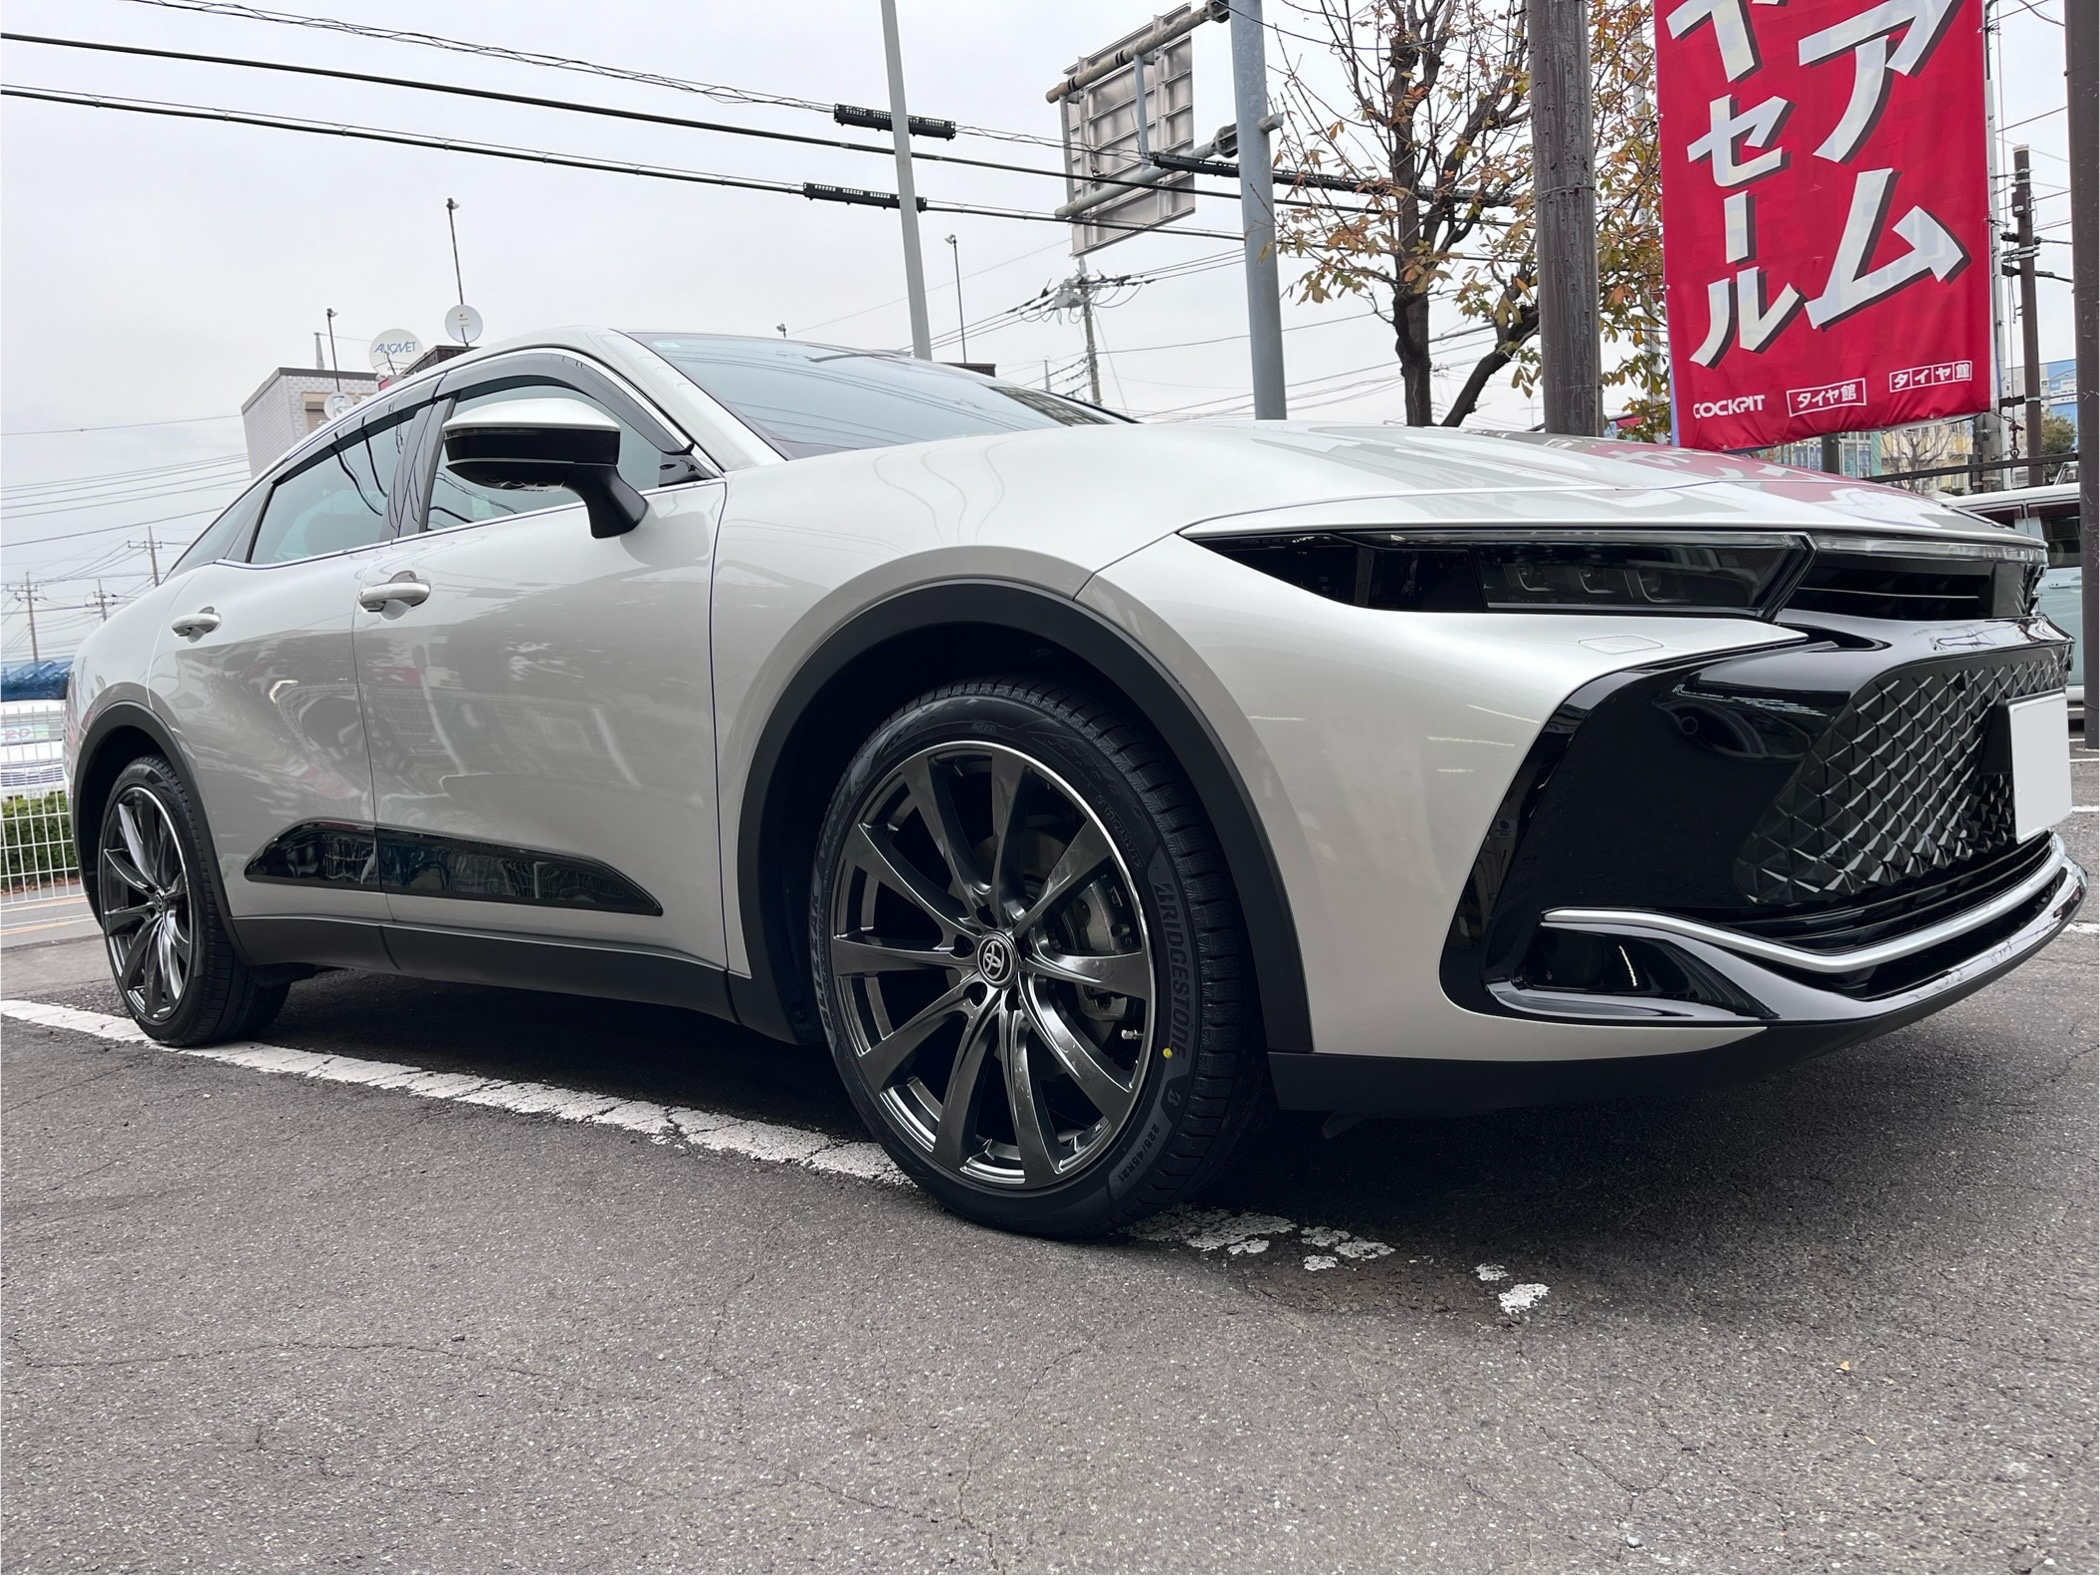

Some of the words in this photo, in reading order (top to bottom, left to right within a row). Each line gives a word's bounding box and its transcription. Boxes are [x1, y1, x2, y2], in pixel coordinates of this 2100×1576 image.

[1893, 363, 1971, 390] タイヤ館
[1693, 394, 1766, 419] COCKPIT
[1796, 383, 1857, 409] タイヤ館
[1152, 882, 1191, 1060] BRIDGESTONE
